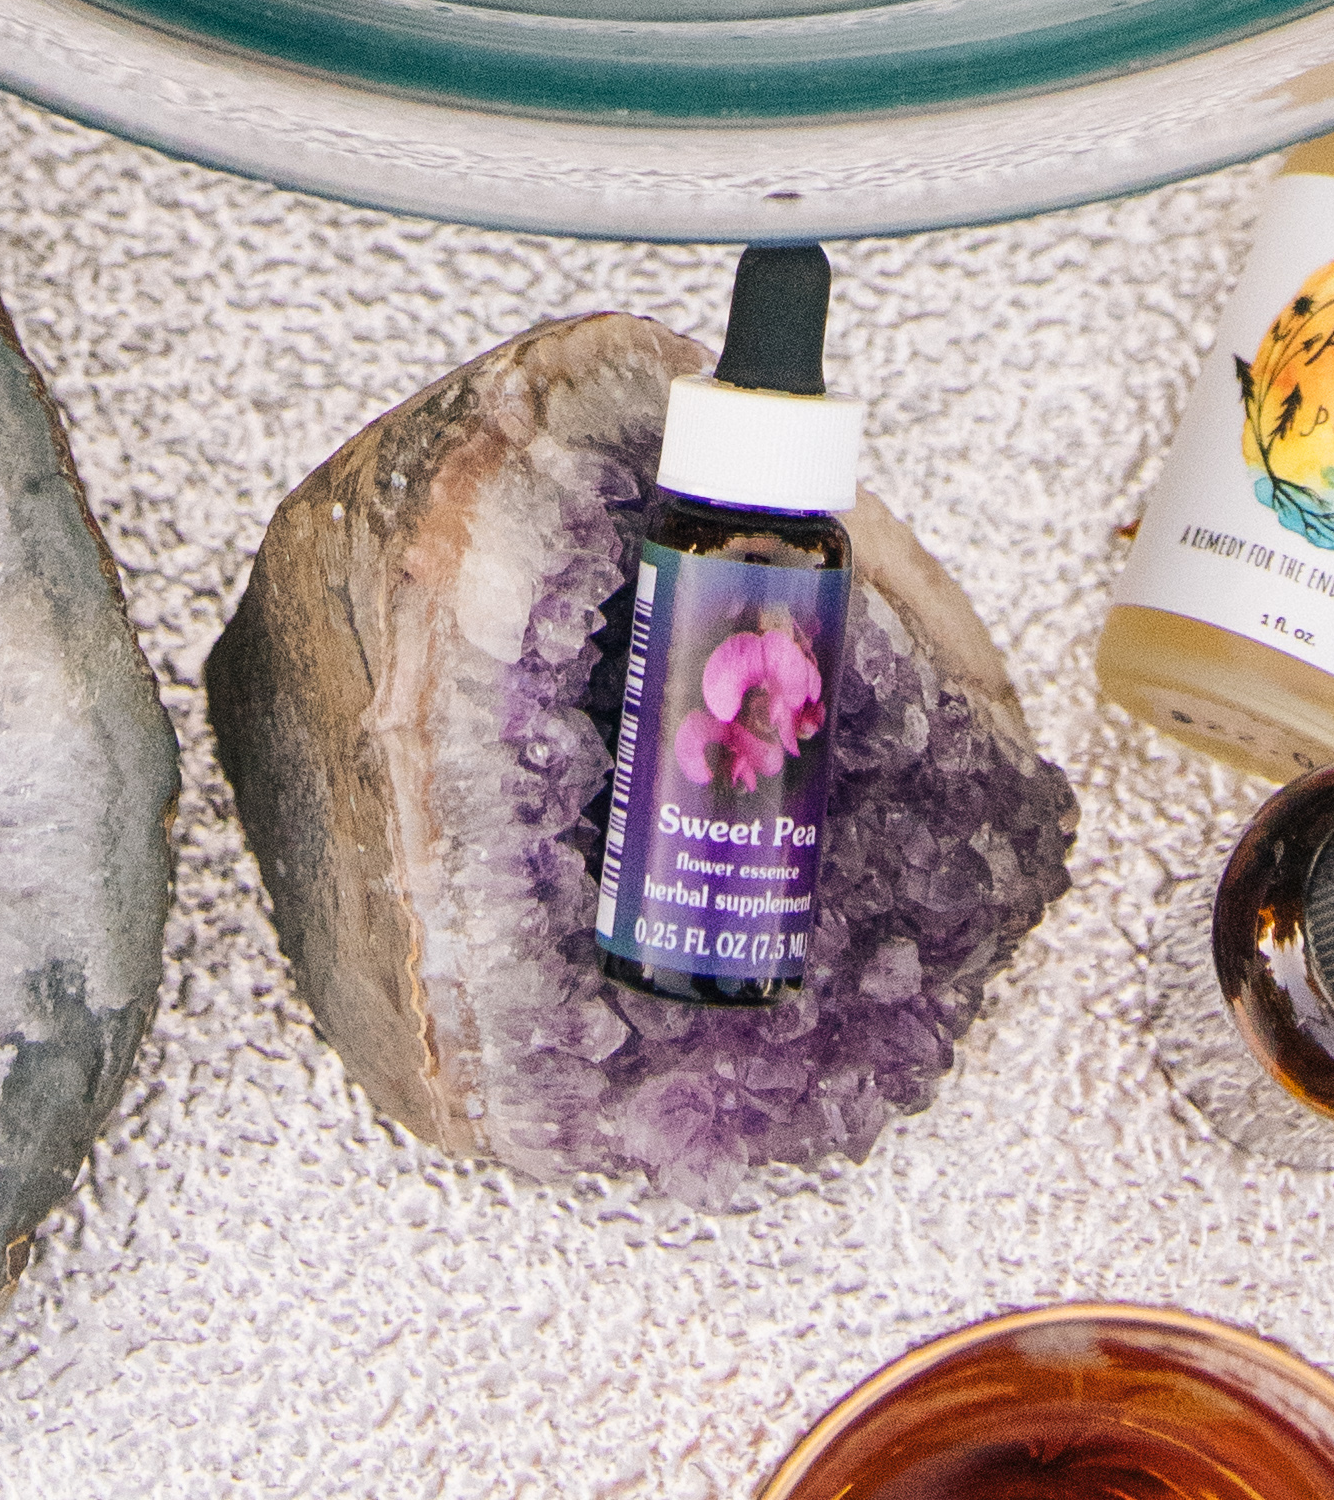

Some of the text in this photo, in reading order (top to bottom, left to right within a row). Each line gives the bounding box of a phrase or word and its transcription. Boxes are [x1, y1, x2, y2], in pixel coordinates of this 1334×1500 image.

[1178, 524, 1193, 546] A
[1190, 526, 1247, 560] REMEDY
[1246, 543, 1276, 573] FOR
[1278, 554, 1306, 584] THE
[1260, 613, 1270, 627] 1
[657, 803, 816, 847] Sweet Pea
[675, 849, 800, 881] flower essence
[643, 874, 812, 918] herbal supplement
[634, 916, 679, 950] 0.25
[683, 926, 710, 956] FL
[716, 930, 749, 960] OZ
[751, 932, 785, 966] (7.5
